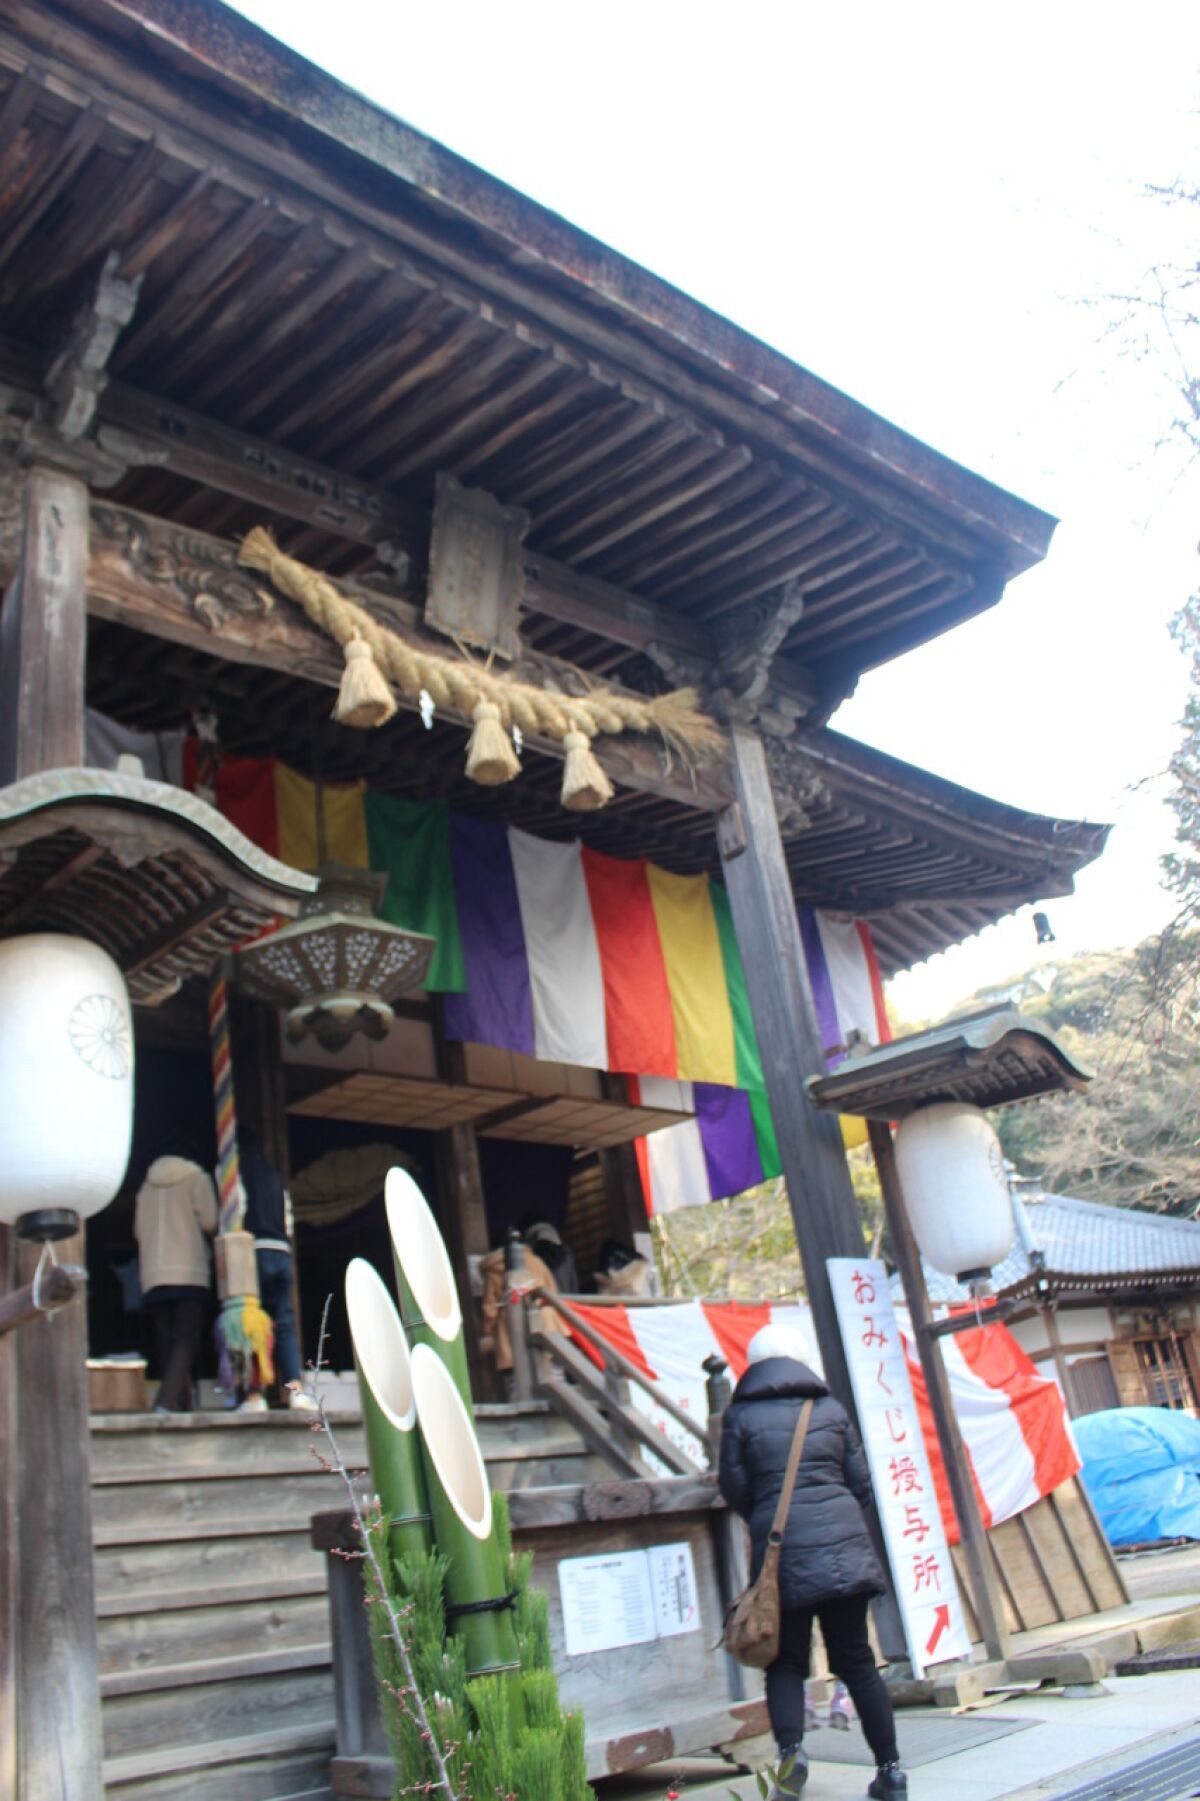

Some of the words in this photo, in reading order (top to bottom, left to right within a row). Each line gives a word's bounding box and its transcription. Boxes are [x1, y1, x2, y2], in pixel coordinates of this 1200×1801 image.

[851, 1270, 940, 1592] おみくじ授与所
